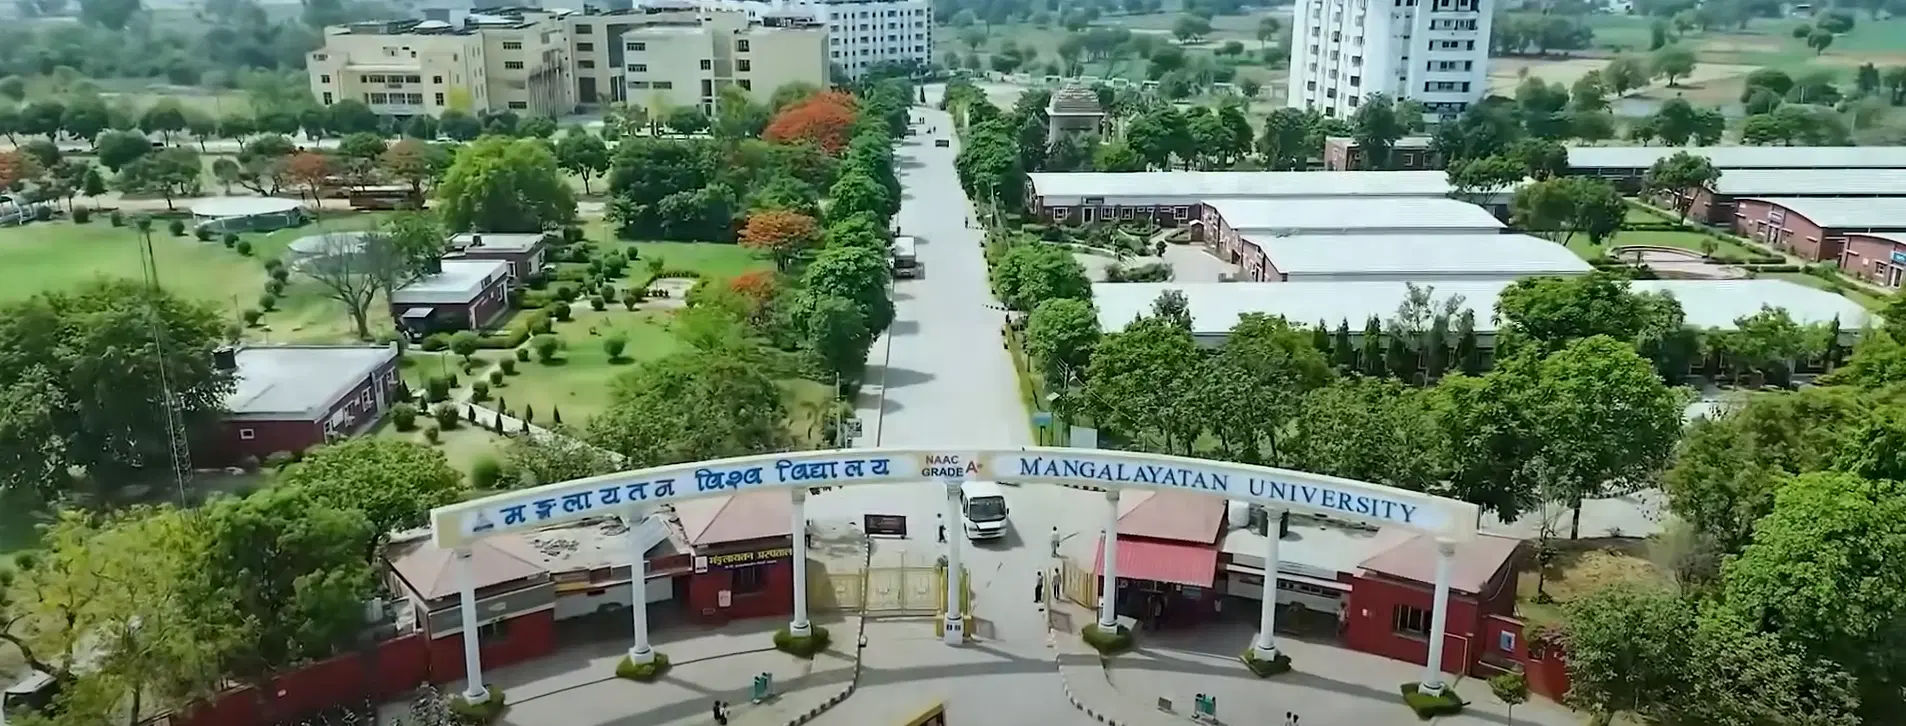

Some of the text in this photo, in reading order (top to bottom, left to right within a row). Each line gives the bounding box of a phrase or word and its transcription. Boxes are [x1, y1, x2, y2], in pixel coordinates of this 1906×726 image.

[925, 455, 959, 465] NAAC
[694, 467, 763, 491] विश्व
[775, 459, 890, 482] विद्यालय
[921, 467, 964, 477] GRADE
[1019, 457, 1417, 523] MANGALAYATAN UNIVERSITY
